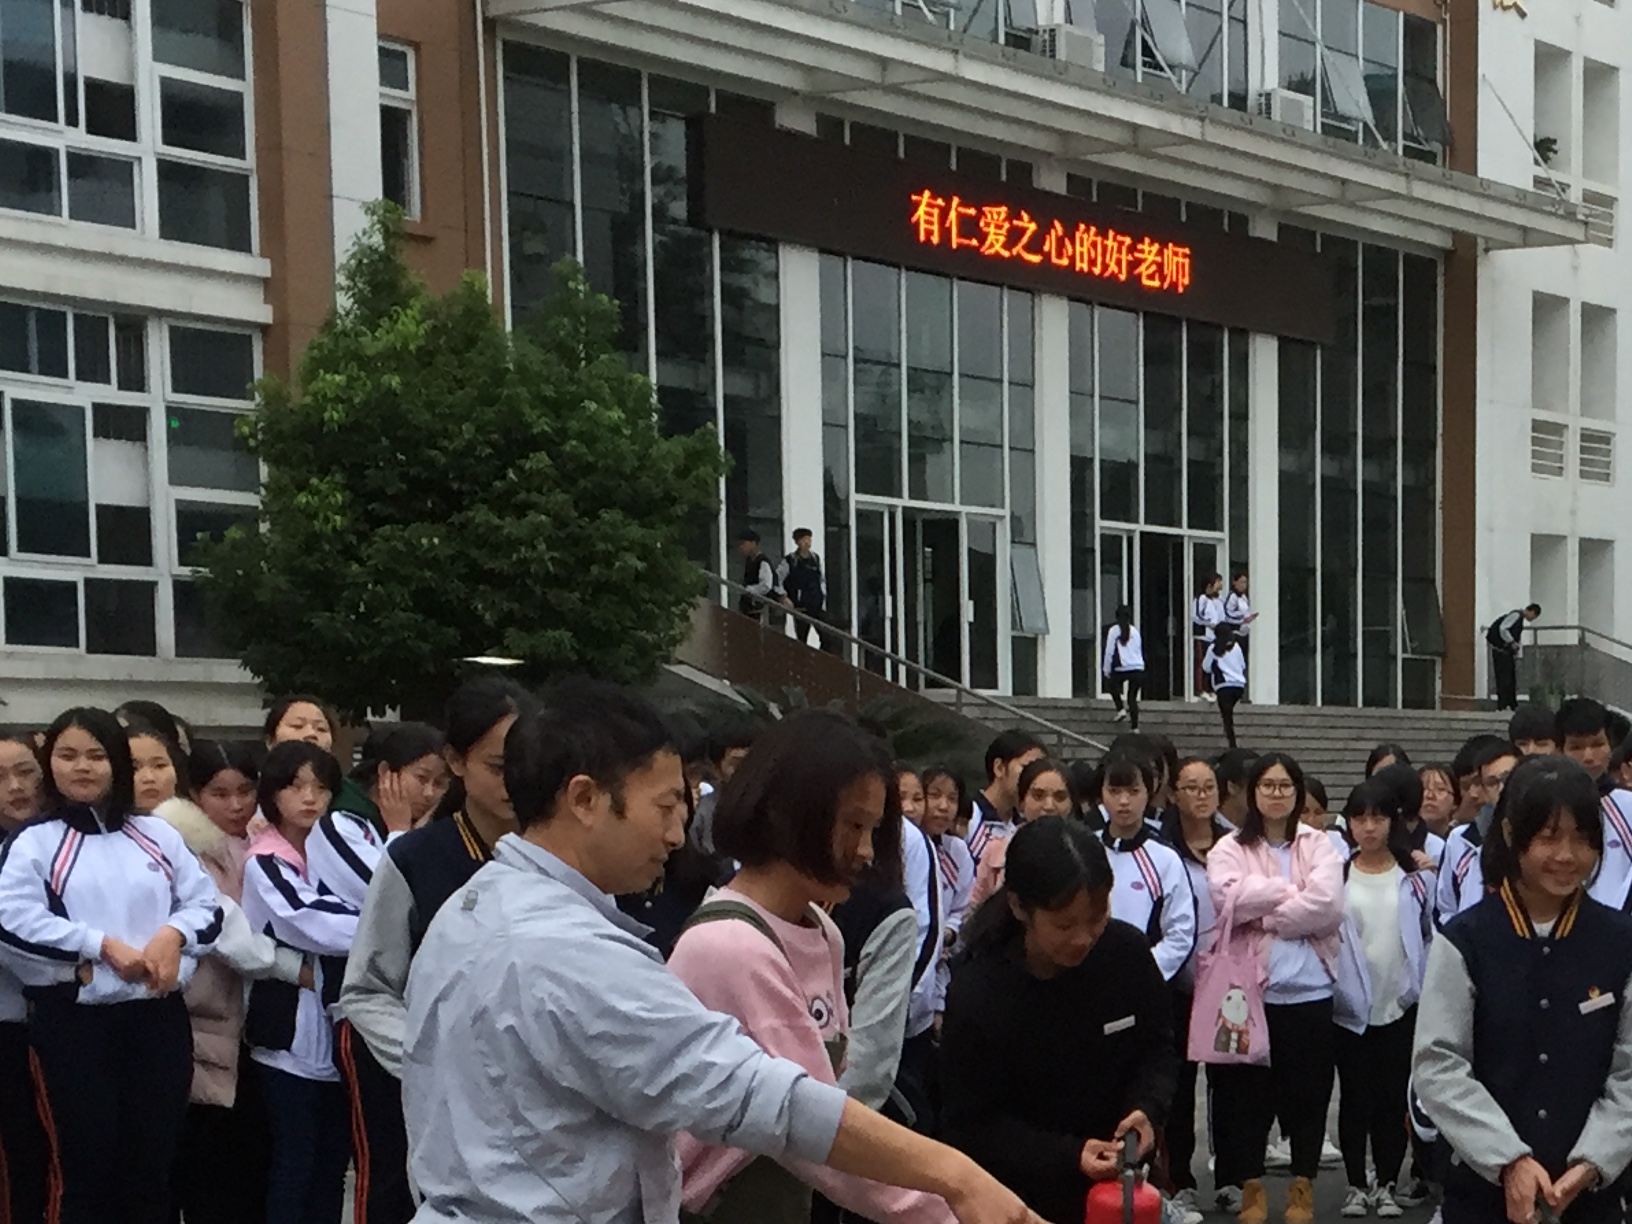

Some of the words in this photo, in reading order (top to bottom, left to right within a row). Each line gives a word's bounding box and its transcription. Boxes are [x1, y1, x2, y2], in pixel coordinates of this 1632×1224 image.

[911, 188, 1190, 293] 有仁爱之心的好老师
